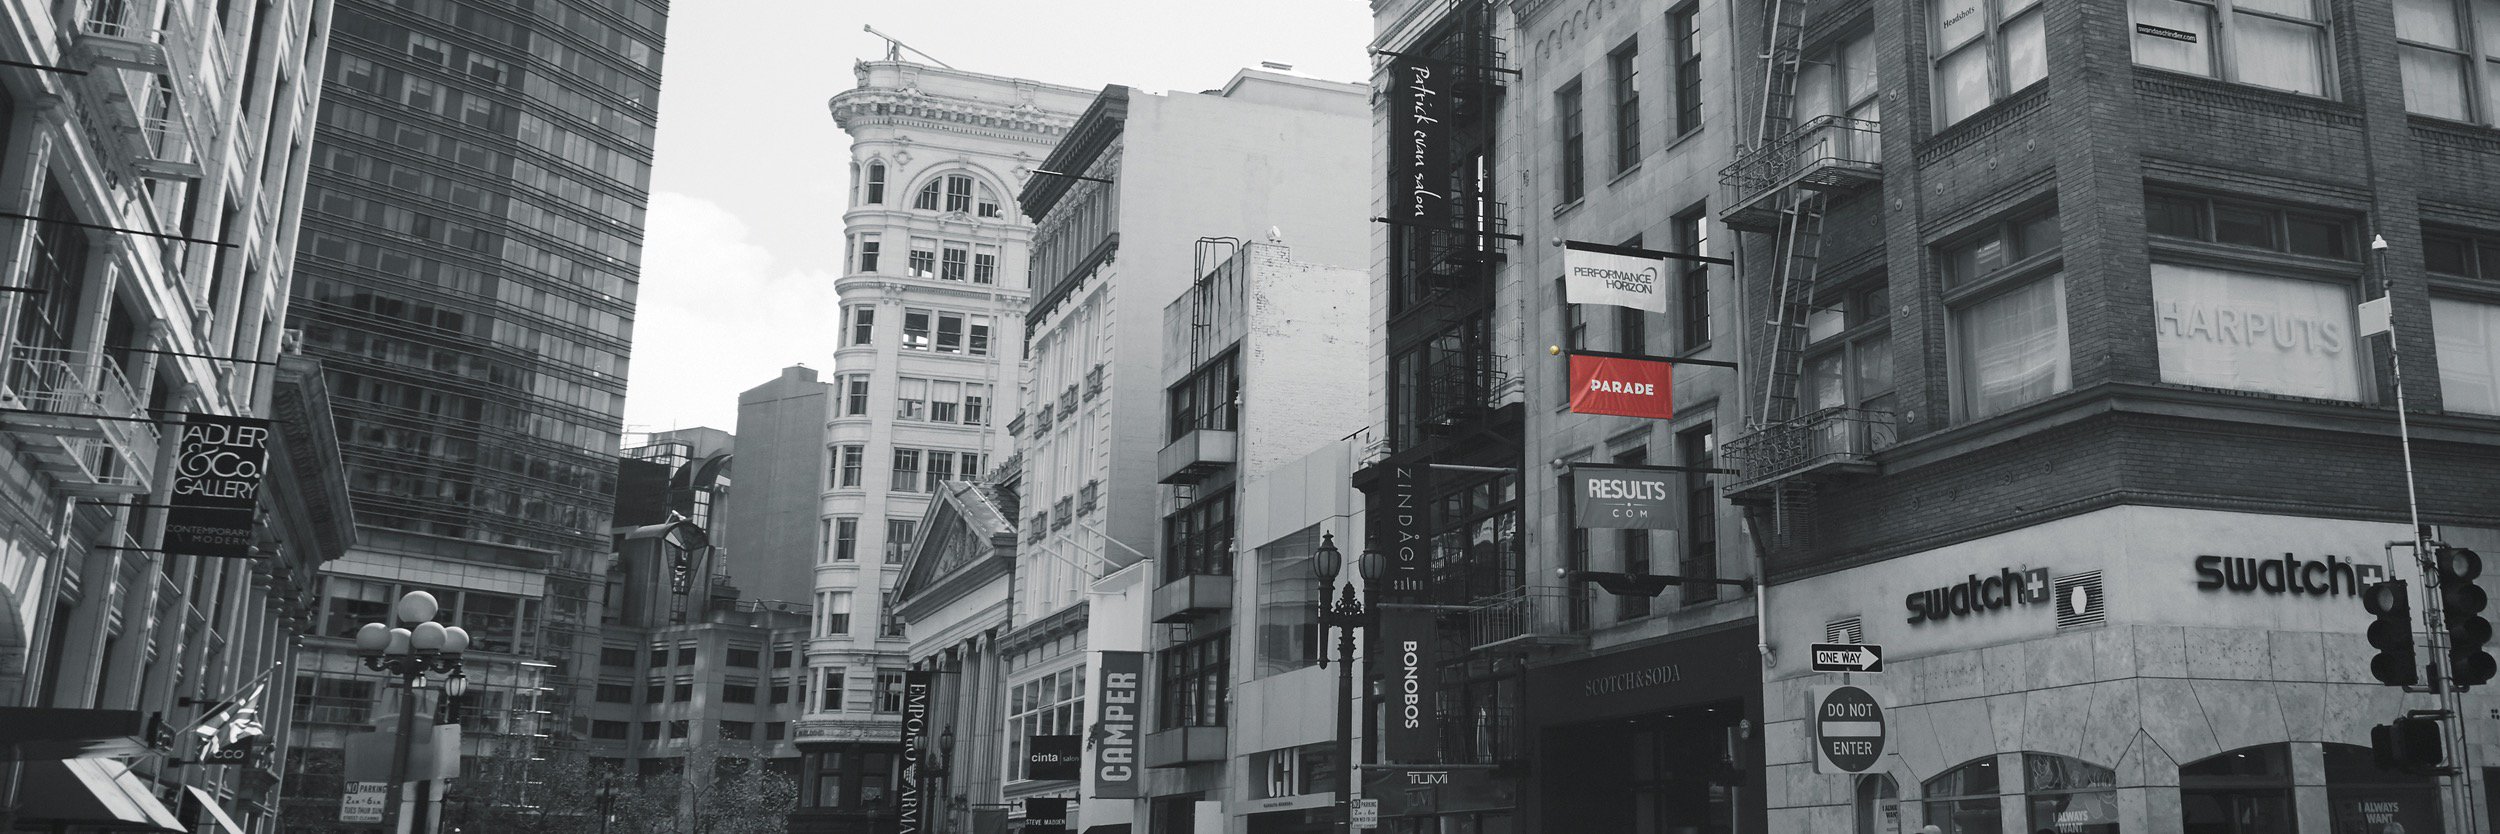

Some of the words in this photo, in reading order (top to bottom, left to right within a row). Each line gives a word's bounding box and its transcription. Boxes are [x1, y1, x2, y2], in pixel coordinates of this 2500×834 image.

[1943, 7, 1975, 29] Headshots
[1410, 66, 1439, 124] Patrick
[1413, 130, 1427, 167] evan
[1414, 172, 1442, 217] salon
[1574, 266, 1652, 285] PERFORMANCE
[1605, 280, 1653, 294] HORIZON
[2156, 300, 2344, 356] HARPUTS
[1590, 378, 1655, 396] PARADE
[182, 423, 269, 449] ADLER
[174, 477, 260, 499] GALLERY
[1588, 478, 1666, 501] RESULTS
[166, 523, 250, 537] CONTEMPORARY
[192, 534, 250, 546] MODERN
[2195, 552, 2357, 598] swatch
[1906, 567, 2026, 625] swatch
[1820, 652, 1838, 663] ONE
[1841, 652, 1861, 664] WAY
[1403, 640, 1419, 729] BONOBOS
[1585, 664, 1682, 697] SCOTCH&SODA
[1827, 703, 1845, 717] DO
[1849, 703, 1873, 717] NOT
[1101, 672, 1137, 782] CAMPER
[1031, 752, 1059, 763] cinta
[1833, 741, 1873, 756] ENTER
[1407, 771, 1448, 785] TUMI
[345, 782, 358, 794] NO
[360, 785, 388, 794] PARKING
[2057, 811, 2089, 822] ALWAYS
[2364, 802, 2399, 813] ALWAYS
[2366, 814, 2393, 824] WANT
[2059, 823, 2083, 834] WANT
